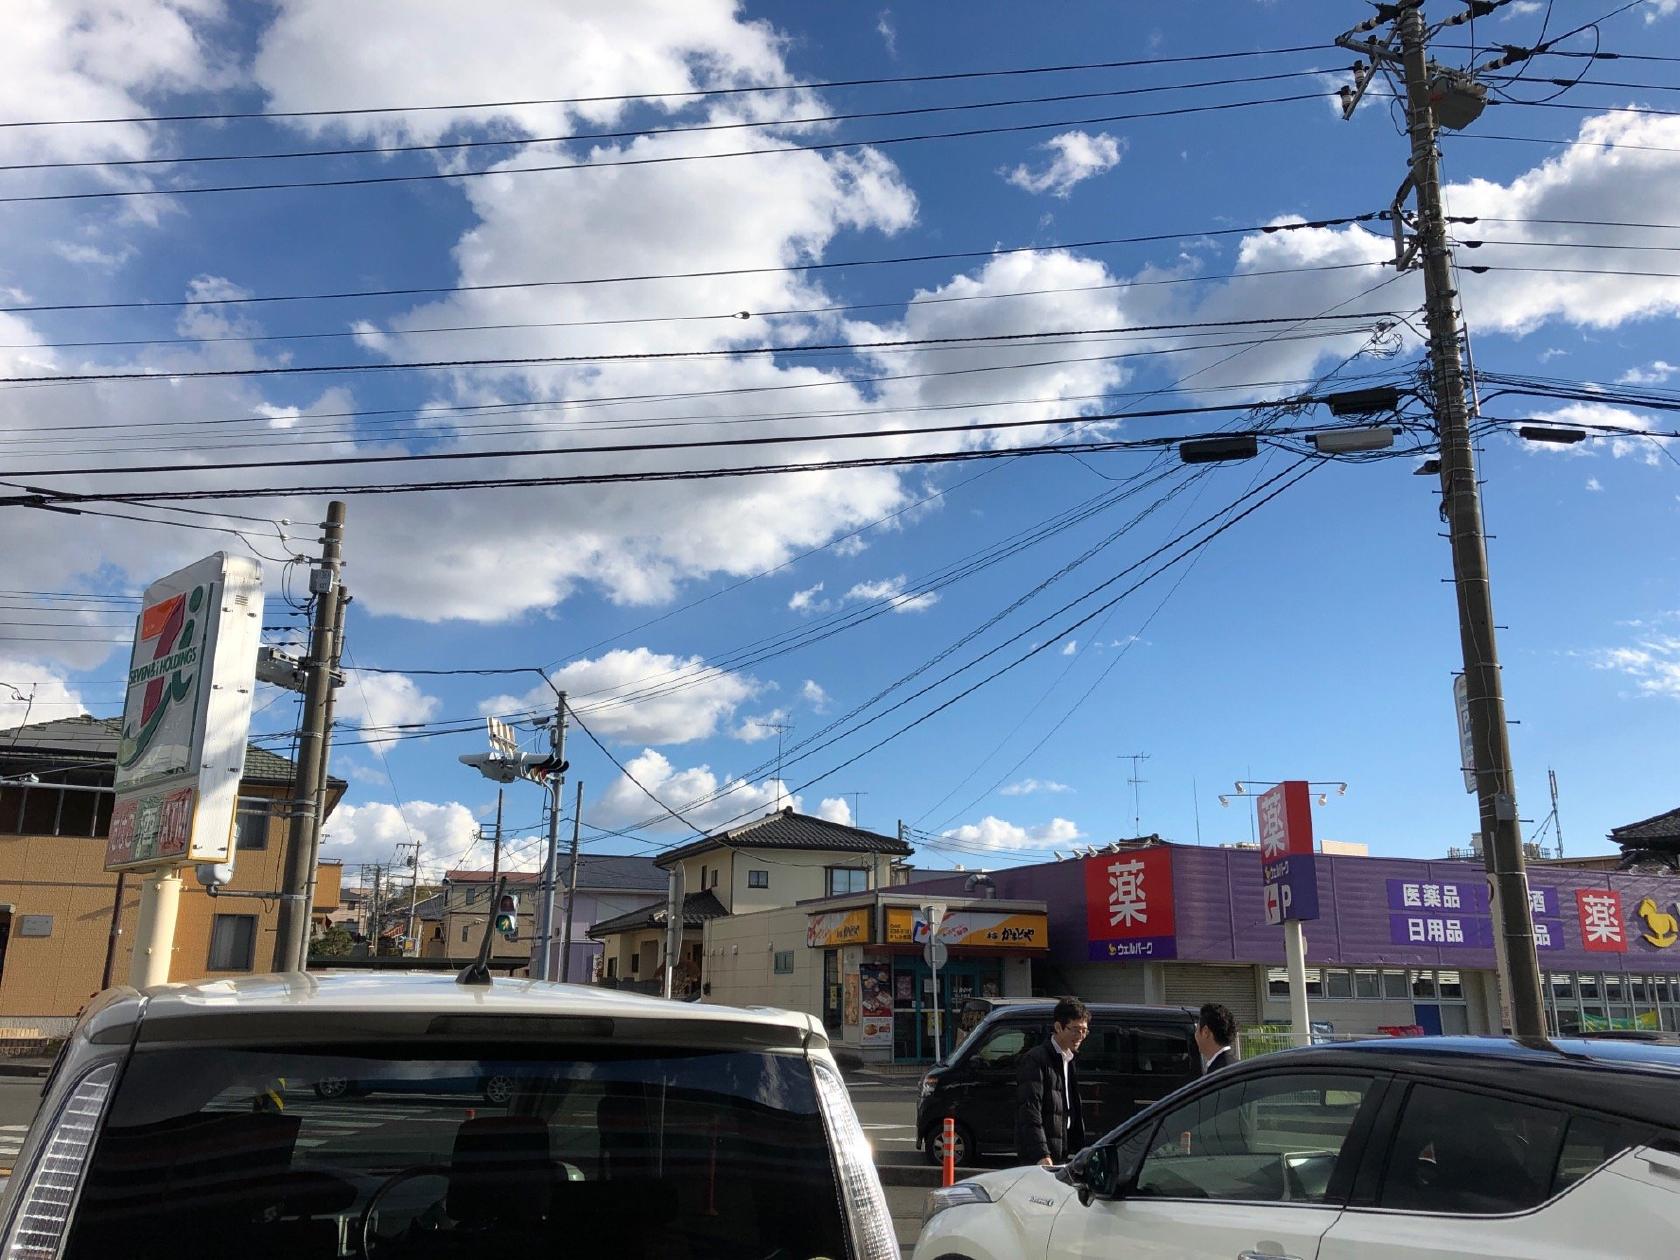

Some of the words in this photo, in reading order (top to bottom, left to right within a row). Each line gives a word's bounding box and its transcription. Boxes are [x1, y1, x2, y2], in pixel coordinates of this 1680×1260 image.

[160, 646, 197, 675] HOLDINGS
[1262, 793, 1286, 858] 薬
[1107, 859, 1148, 928] 薬
[1281, 884, 1292, 918] P
[1402, 883, 1461, 909] 医薬品
[1408, 918, 1464, 943] 日用品
[1582, 895, 1621, 943] 薬
